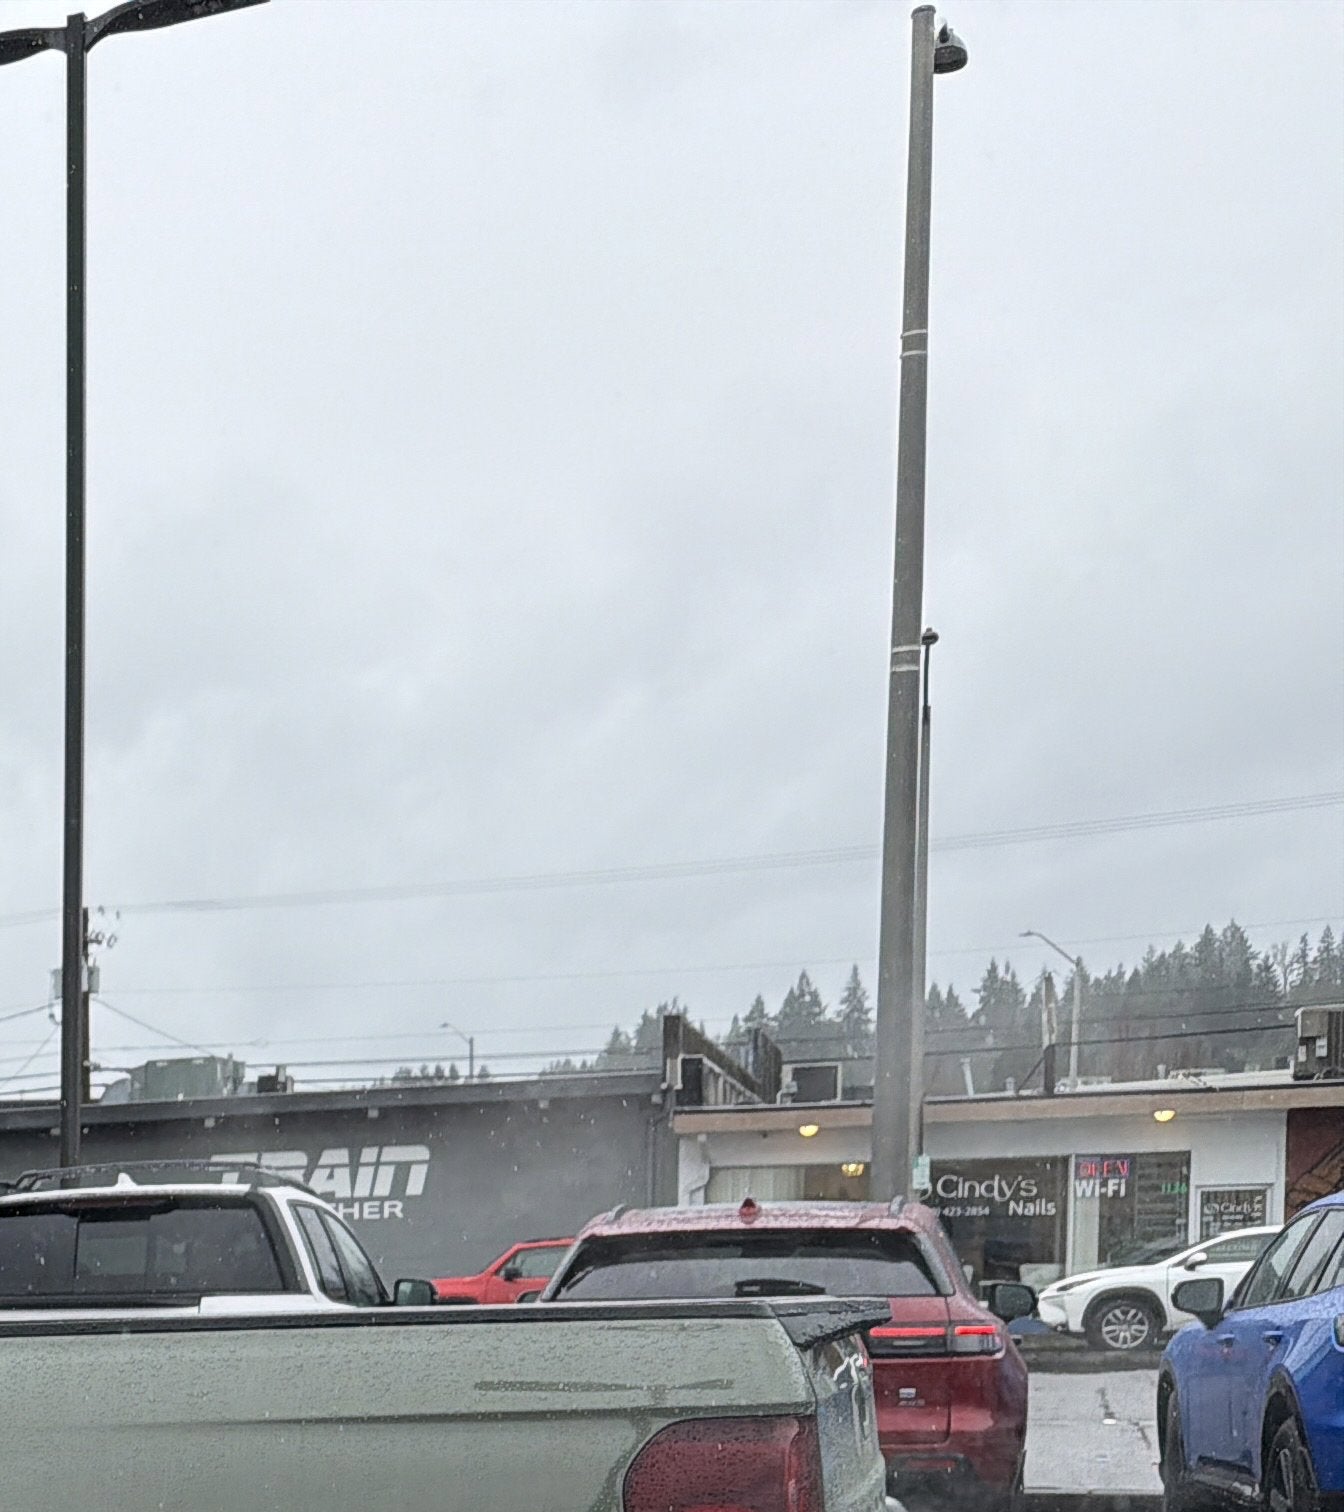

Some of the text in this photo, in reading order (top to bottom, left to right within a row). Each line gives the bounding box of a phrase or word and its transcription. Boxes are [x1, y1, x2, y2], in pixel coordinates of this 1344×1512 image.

[936, 1173, 1038, 1203] Cindy's
[1074, 1178, 1126, 1198] Wi-Fi
[1008, 1198, 1056, 1217] Nails
